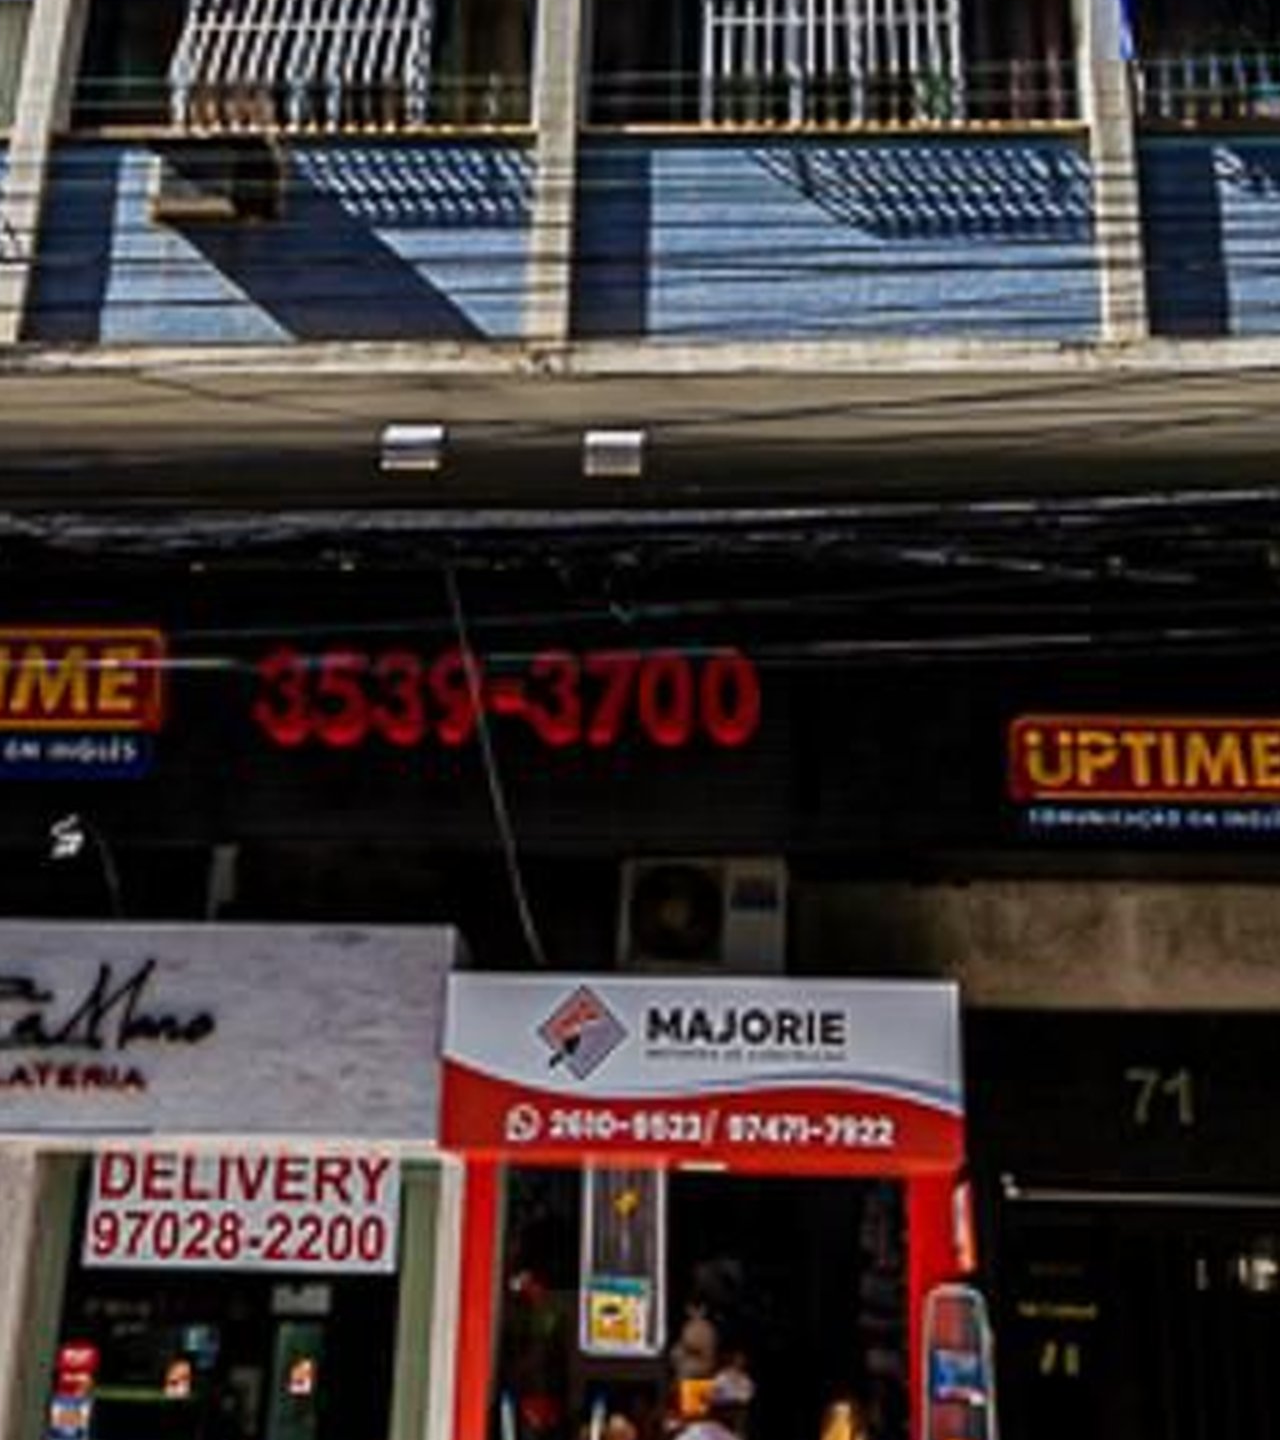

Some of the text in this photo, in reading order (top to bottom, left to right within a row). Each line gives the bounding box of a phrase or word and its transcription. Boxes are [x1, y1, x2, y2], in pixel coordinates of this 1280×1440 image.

[255, 647, 761, 747] 3539-3700
[646, 1009, 846, 1048] MAJORIE
[1125, 1067, 1195, 1126] 71
[99, 1151, 392, 1203] DELIVERY
[91, 1212, 386, 1263] 97028-2200
